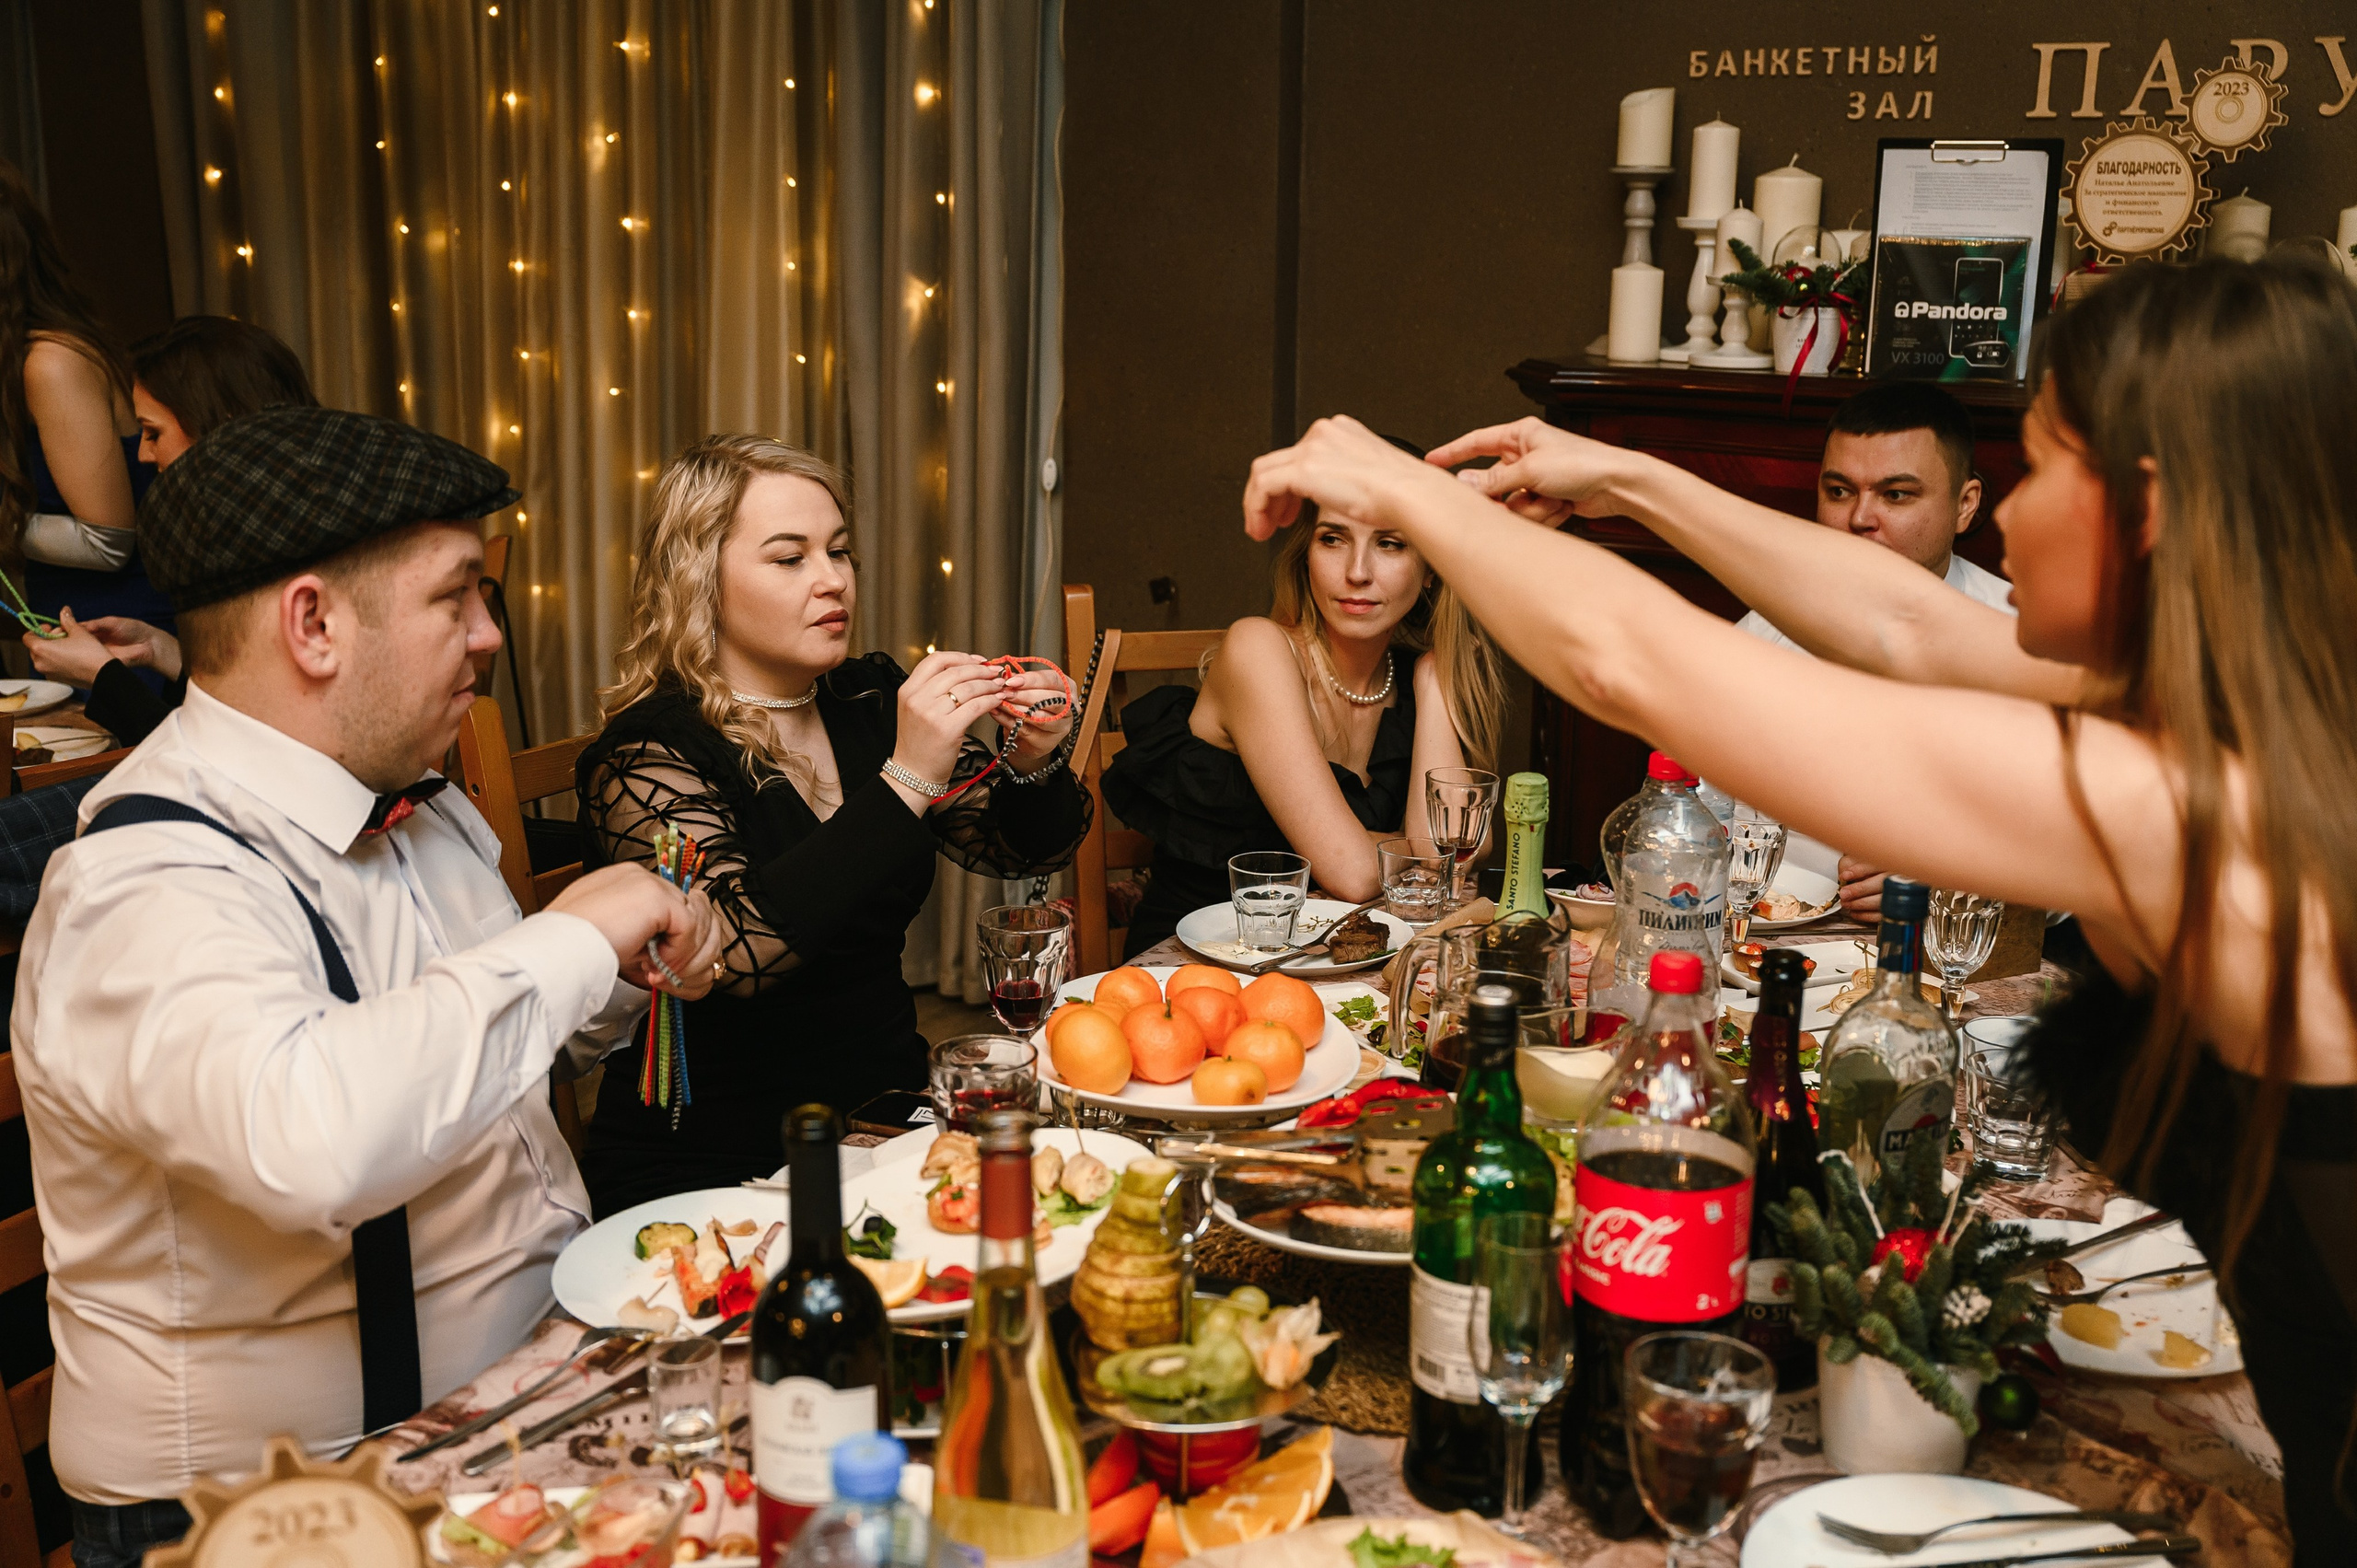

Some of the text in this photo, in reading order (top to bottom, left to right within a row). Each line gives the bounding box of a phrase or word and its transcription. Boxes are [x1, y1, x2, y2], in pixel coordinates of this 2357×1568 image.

[1689, 34, 1938, 77] БАНКЕТНЫЙ
[2212, 81, 2250, 97] 2023
[1847, 91, 1933, 120] ЗАЛ
[2096, 161, 2182, 176] БЛАГОДАРНОСТЬ
[2112, 199, 2160, 207] финансовую
[1911, 301, 2008, 320] Pandora
[1891, 351, 1945, 366] VX 3100
[1505, 832, 1521, 911] SANTO STEFANO
[1582, 1207, 1686, 1278] Cola
